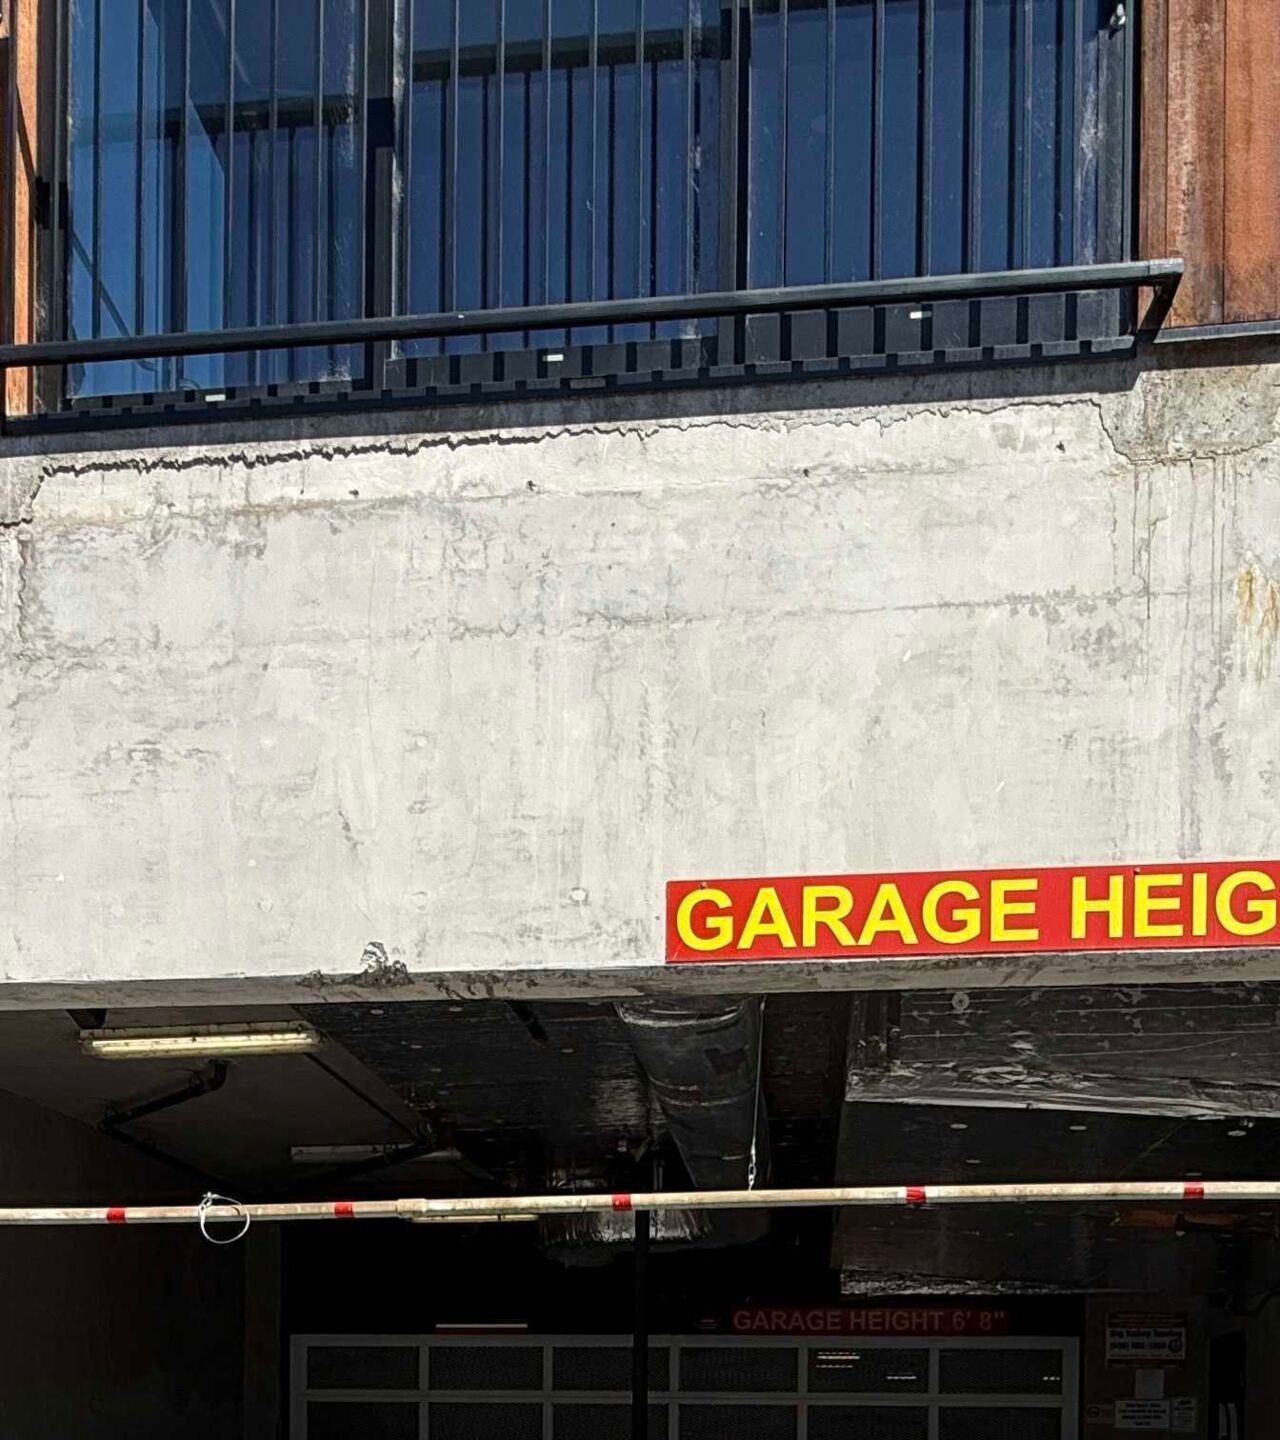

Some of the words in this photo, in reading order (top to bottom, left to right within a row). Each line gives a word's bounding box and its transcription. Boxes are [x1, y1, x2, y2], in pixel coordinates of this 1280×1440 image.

[676, 878, 1039, 951] GARAGE
[733, 1310, 842, 1331] GARAGE
[849, 1310, 945, 1331] HEIGHT
[951, 1310, 973, 1331] 6'
[979, 1309, 1005, 1331] 8"
